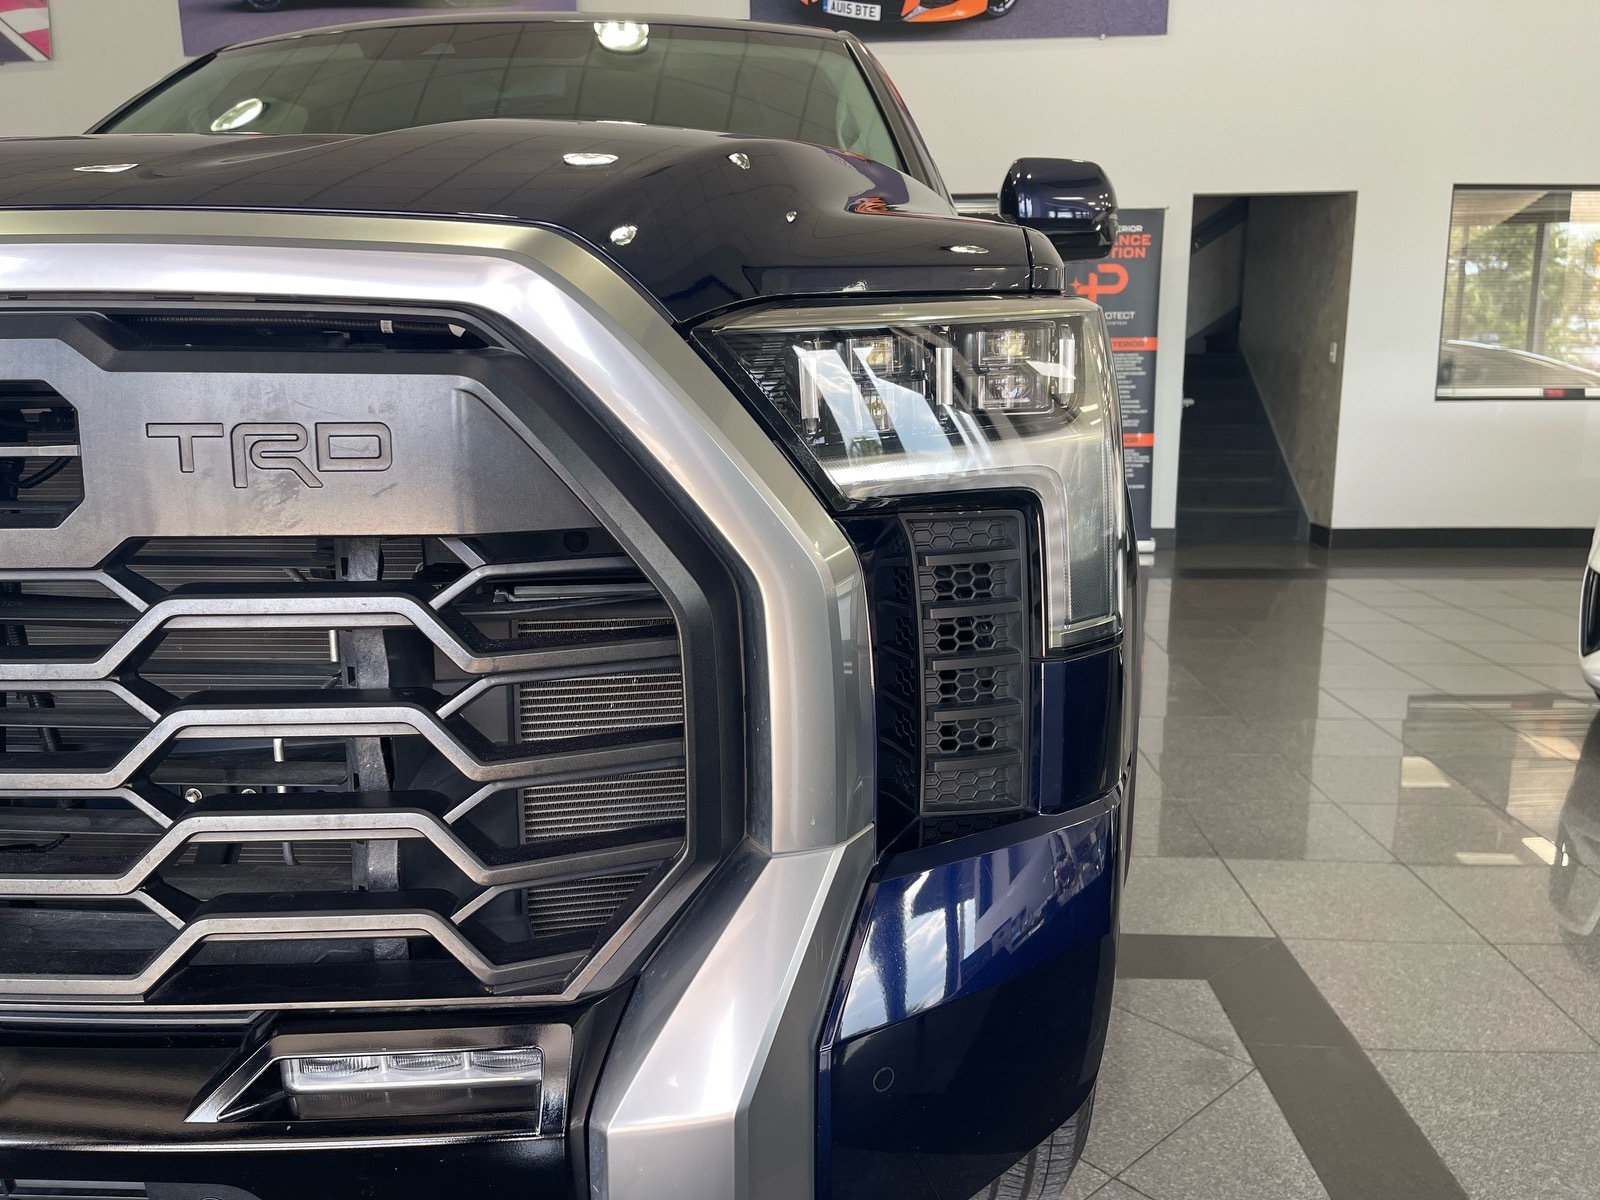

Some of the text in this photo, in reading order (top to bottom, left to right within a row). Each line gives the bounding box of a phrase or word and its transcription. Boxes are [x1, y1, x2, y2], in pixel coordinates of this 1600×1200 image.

[855, 4, 876, 18] BTE
[1115, 233, 1151, 246] NCE
[145, 422, 393, 488] TRD
